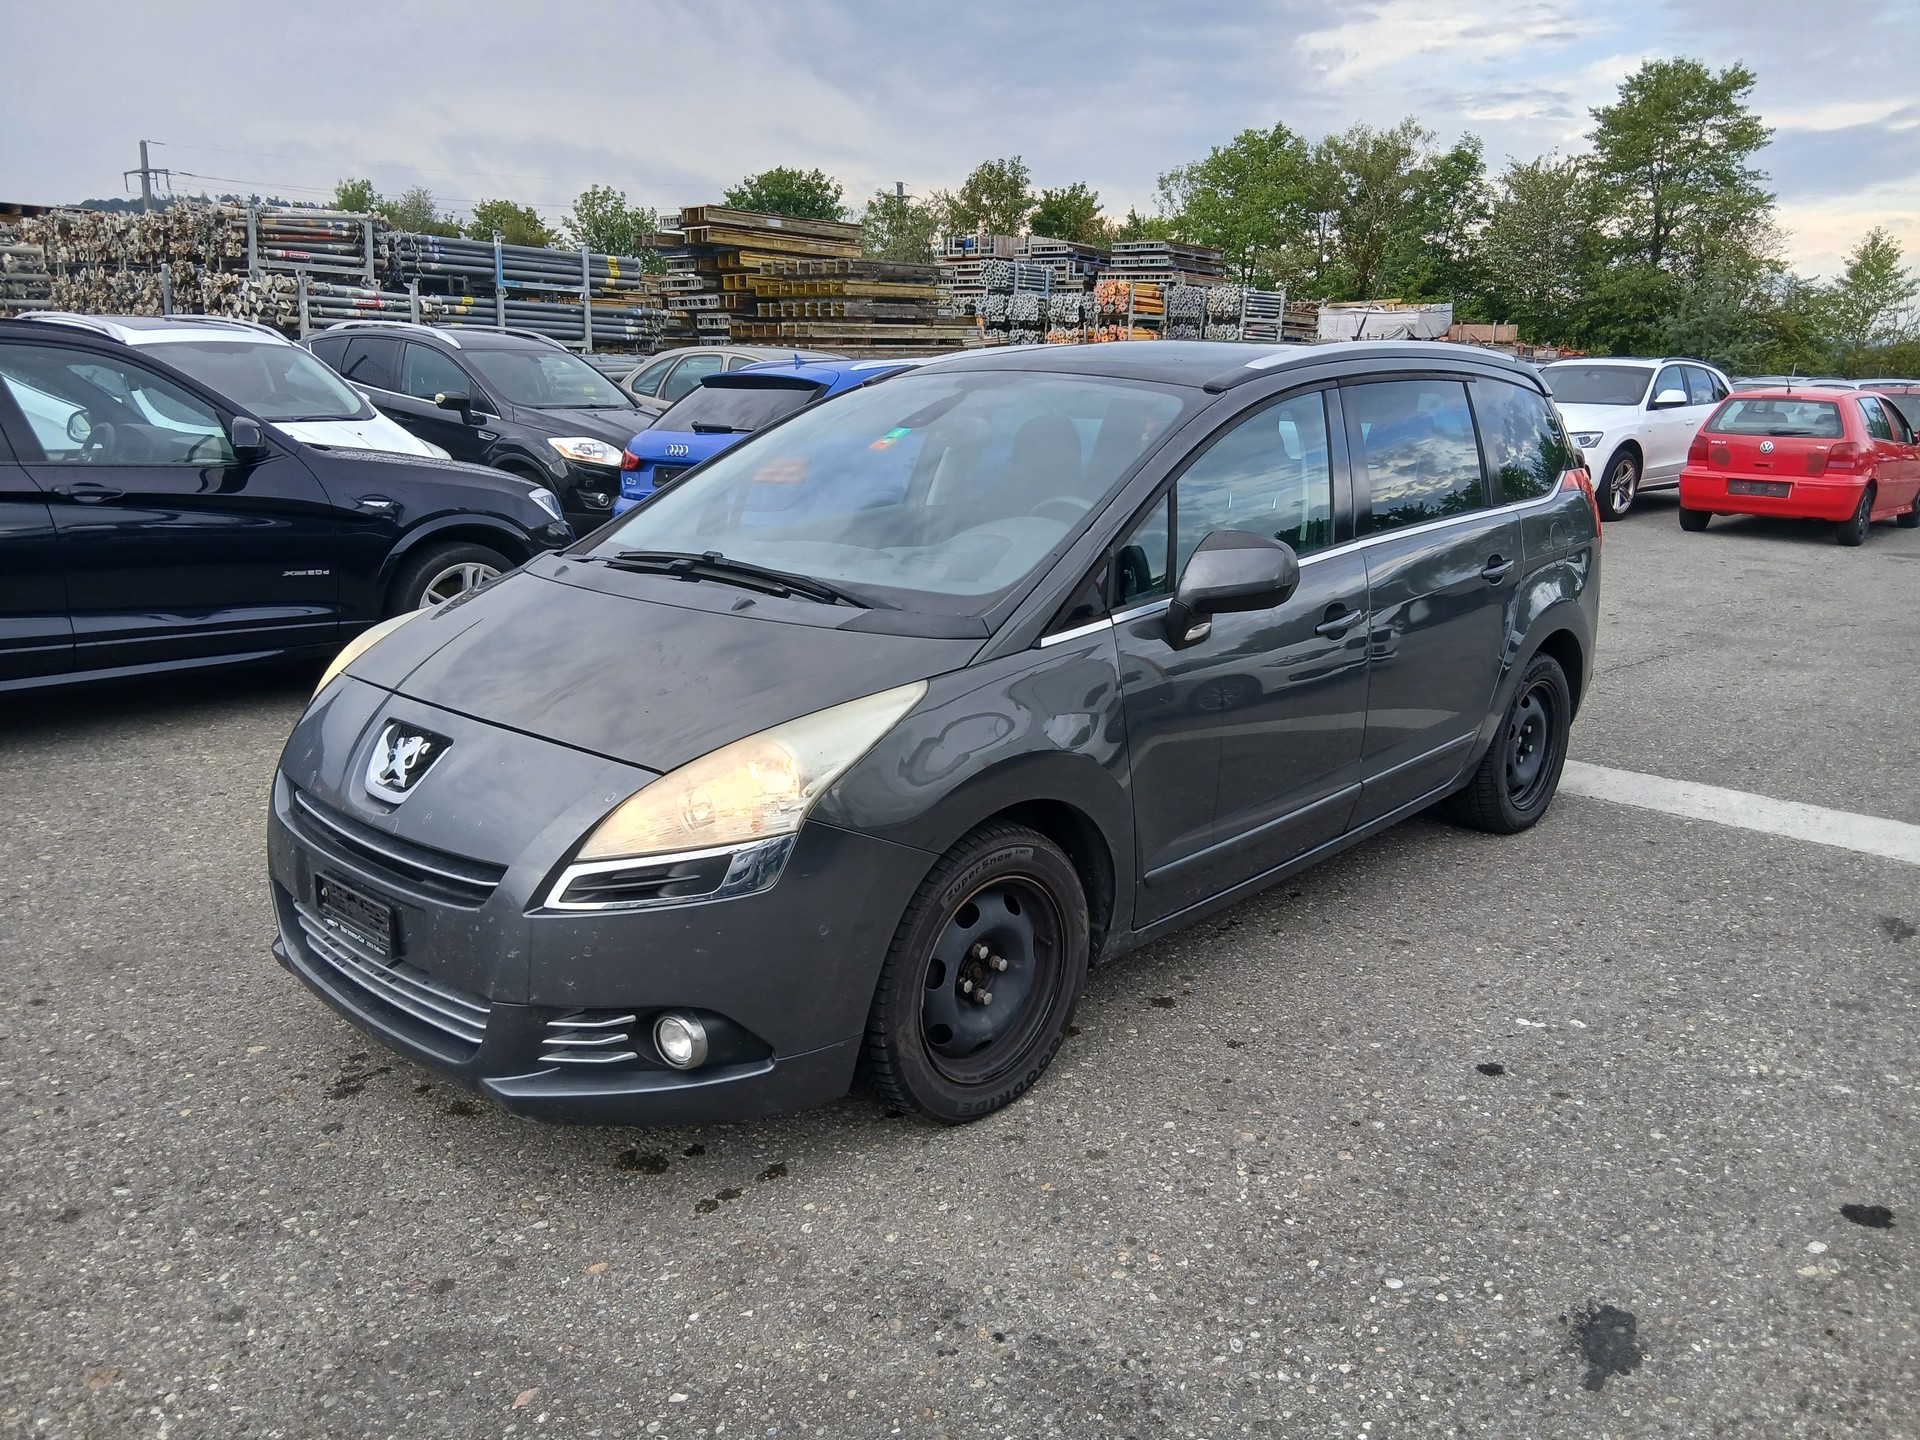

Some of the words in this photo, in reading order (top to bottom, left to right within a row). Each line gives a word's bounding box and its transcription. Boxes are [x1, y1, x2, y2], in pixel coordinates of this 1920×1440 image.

[282, 569, 330, 577] xD20d
[946, 852, 1013, 901] ZuperSnow
[960, 1037, 1060, 1113] GOODRIDE
